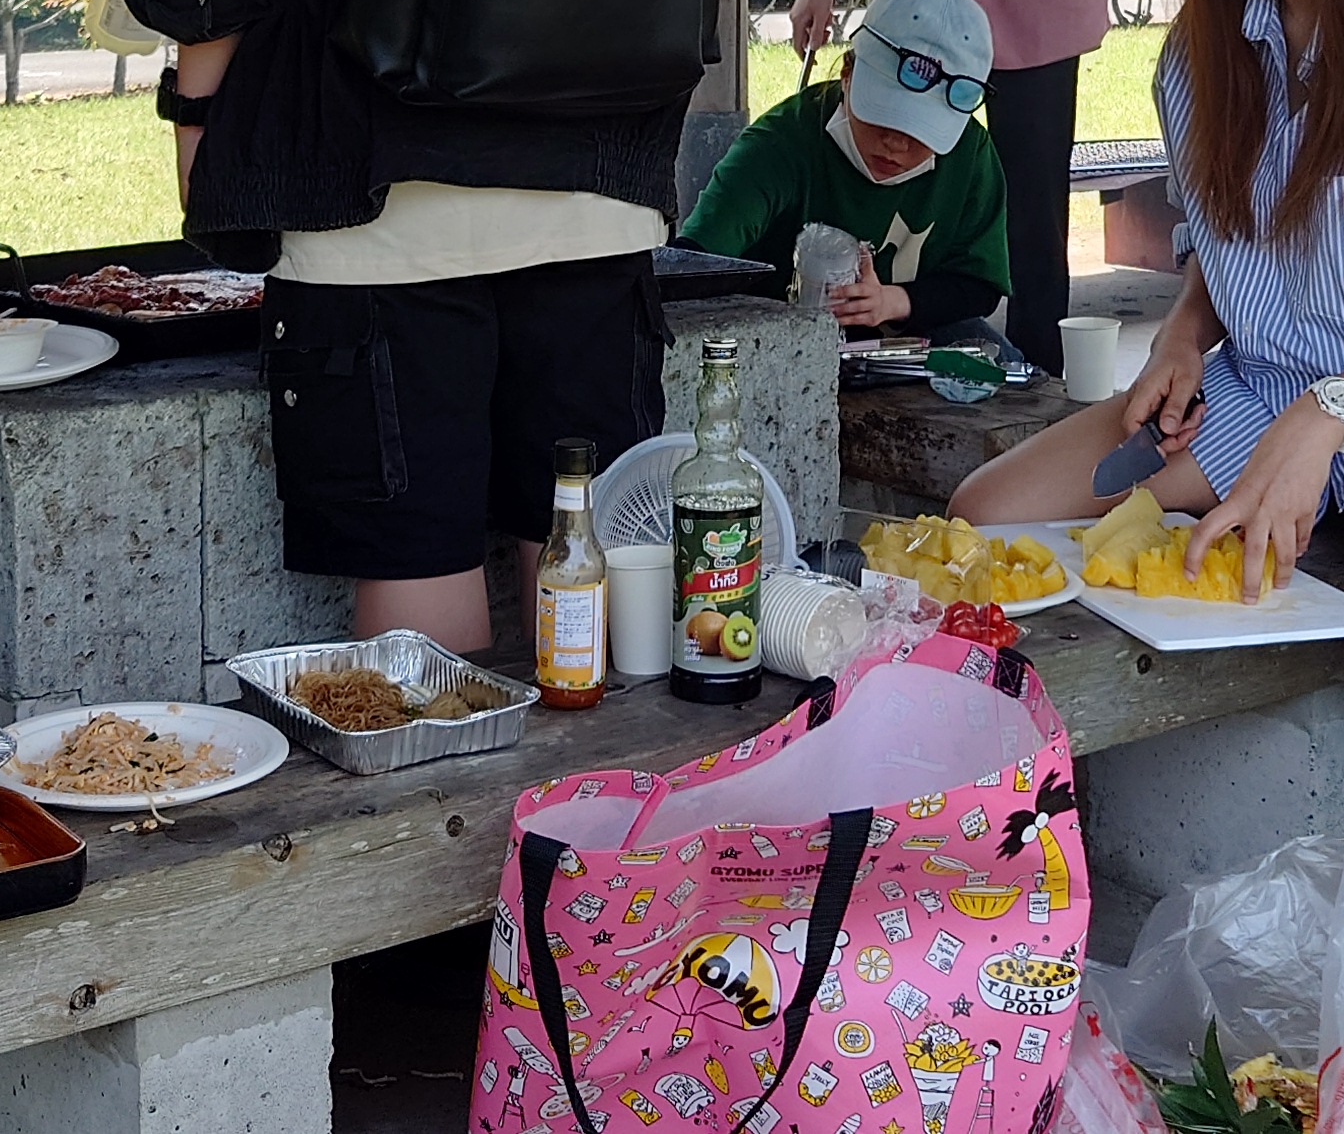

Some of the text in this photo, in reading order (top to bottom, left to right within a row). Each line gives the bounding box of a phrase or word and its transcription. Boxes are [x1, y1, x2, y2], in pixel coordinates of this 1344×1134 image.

[711, 866, 774, 876] GYOMU
[653, 947, 777, 1026] GYOMU
[987, 980, 1076, 1002] TAPIOCA
[1003, 1001, 1053, 1015] POOL
[811, 1072, 831, 1087] JELLY
